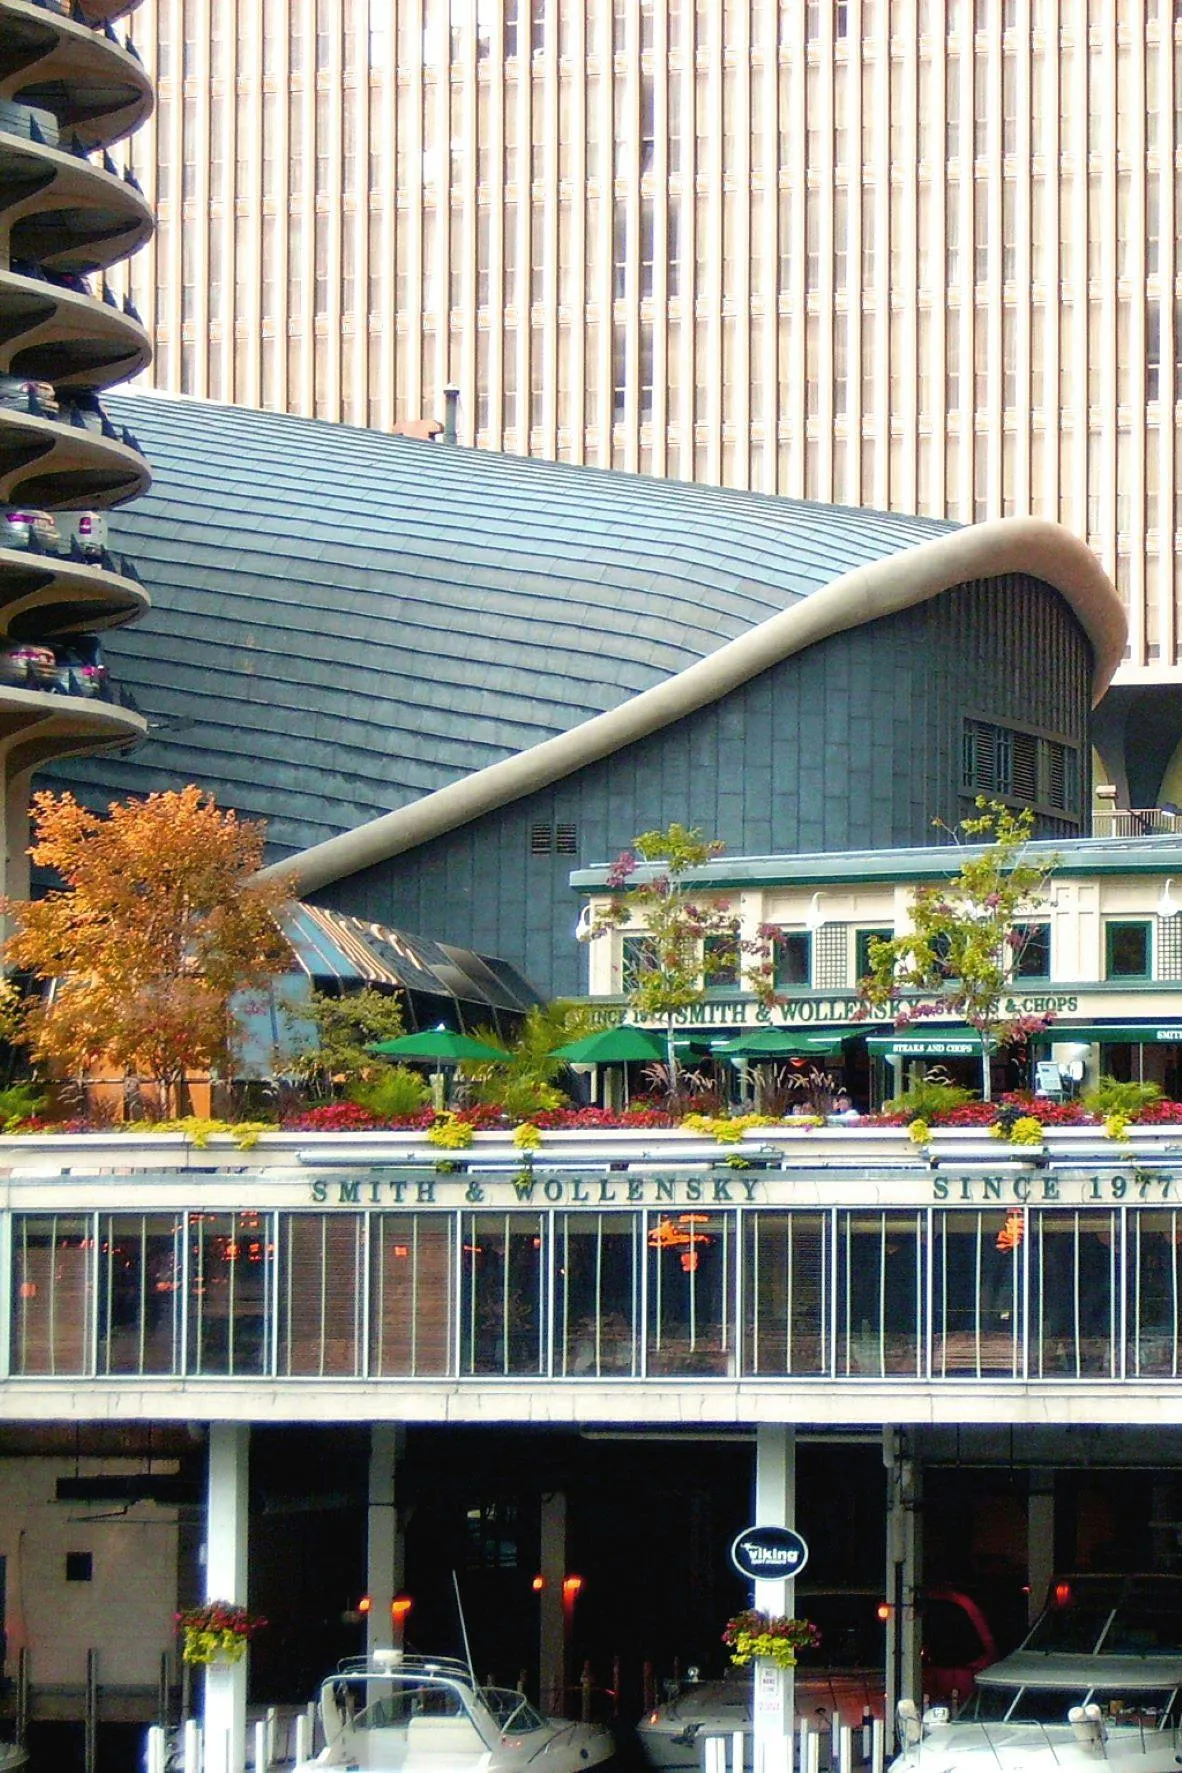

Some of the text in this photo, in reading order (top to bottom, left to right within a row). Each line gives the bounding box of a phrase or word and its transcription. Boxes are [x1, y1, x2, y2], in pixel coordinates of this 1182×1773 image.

[675, 1002, 747, 1025] SMITH
[755, 1002, 772, 1023] &
[1005, 997, 1019, 1013] &
[1022, 996, 1078, 1013] CHOPS
[893, 1043, 973, 1053] STEAKS AND CHOPS
[312, 1176, 759, 1203] SMITH & WOLLENSKY
[933, 1175, 1175, 1200] SINCE 1977
